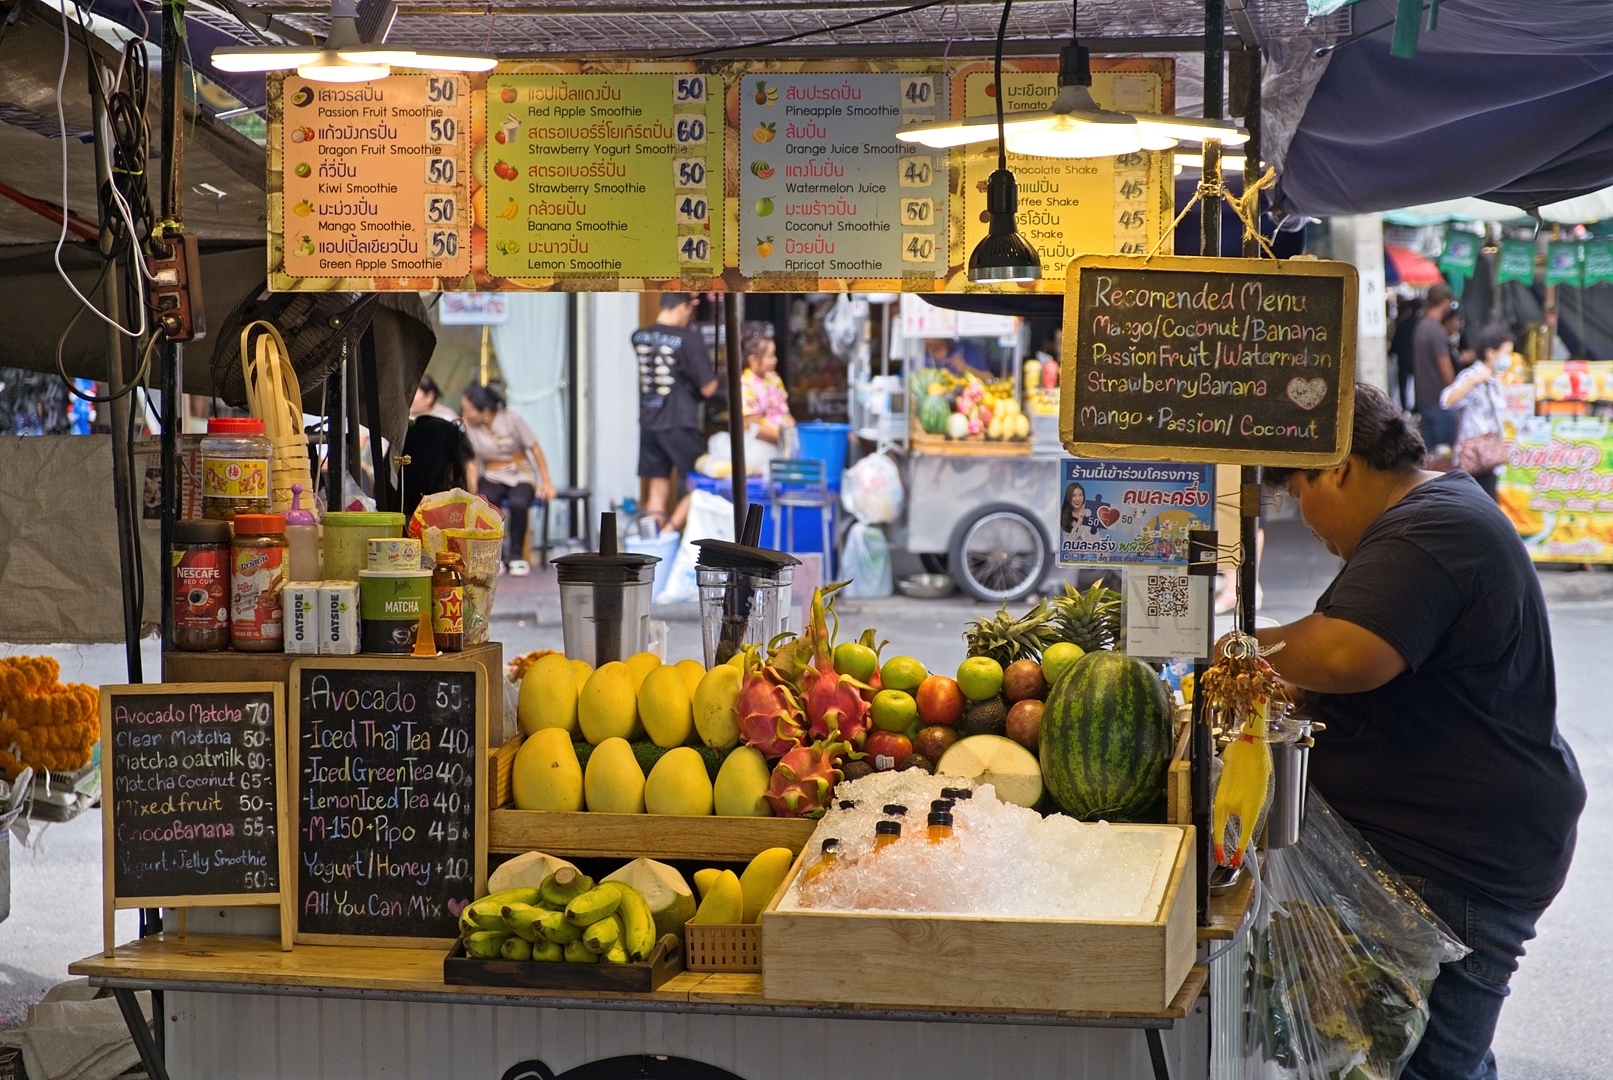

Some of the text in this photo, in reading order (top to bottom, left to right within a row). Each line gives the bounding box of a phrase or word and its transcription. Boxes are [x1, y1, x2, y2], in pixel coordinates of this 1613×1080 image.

[318, 82, 383, 102] เสาวรสปั่น
[429, 78, 454, 101] 50
[528, 81, 621, 100] แอปเปิ้ลแดงปั่น
[677, 78, 703, 100] 50
[786, 80, 861, 99] สับปะรดปั่น
[906, 82, 930, 103] 40
[318, 107, 443, 117] Passion Fruit Smoothie
[528, 106, 642, 118] Red Apple Smoothie
[786, 106, 899, 117] Pineapple Smoothie
[1008, 101, 1047, 109] Tomato
[318, 120, 396, 139] แก้วมังกรปั่น
[430, 118, 454, 141] 50
[677, 119, 704, 142] 60
[786, 119, 826, 138] ส้มปั่น
[318, 145, 441, 156] Dragon Fruit Smoothie
[529, 145, 589, 156] Strawberry
[594, 145, 631, 156] Yogurt
[786, 144, 916, 156] Orange Juice Smoothie
[428, 159, 454, 183] 50
[680, 163, 704, 185] 50
[786, 158, 843, 177] แตงโมปั่น
[905, 162, 930, 183] 40
[1066, 166, 1097, 174] Shake
[319, 183, 397, 193] Kiwi Smoothie
[529, 183, 646, 195] Strawberry Smoothie
[786, 183, 886, 193] Watermelon Juice
[1120, 180, 1146, 199] 45
[319, 196, 377, 215] มะม่วงปั่น
[429, 199, 454, 222] 50
[528, 196, 586, 215] กล้วยปั่น
[680, 197, 706, 219] 40
[786, 196, 856, 215] มะพร้าวปั่น
[907, 202, 929, 221] 50
[1017, 198, 1078, 206] offee Shake
[319, 221, 411, 233] Mango Smoothie
[528, 221, 627, 231] Banana Smoothie
[785, 221, 890, 231] Coconut Smoothie
[1119, 210, 1146, 229] 45
[432, 231, 457, 256] 50
[1031, 230, 1063, 238] Shake
[528, 235, 588, 254] มะนาวปั่น
[681, 238, 707, 259] 40
[907, 237, 932, 257] 40
[320, 259, 442, 271] Green Apple Smoothie
[528, 259, 621, 269] Lemon Smoothie
[785, 260, 882, 271] Apricot Smoothie
[1095, 276, 1307, 311] Recomended Menu
[1080, 405, 1142, 430] Mango
[1241, 415, 1318, 439] Coconut
[1072, 463, 1199, 481] ร้านนี้เข้าร่วมโครงการ
[1123, 482, 1209, 506] คนละครึ่ง
[1088, 515, 1132, 527] 50 50
[1063, 535, 1116, 551] คนละครึ่ง
[386, 602, 419, 612] MATCHA
[446, 602, 461, 616] M
[295, 594, 304, 641] OATSIDE
[331, 595, 339, 641] OATSIDE
[115, 703, 270, 725] Avocado Matcha 70
[117, 731, 162, 747] Clear
[171, 731, 231, 745] Matcha
[117, 752, 178, 770] Matcha
[116, 773, 174, 792] Matcha
[178, 772, 235, 787] Coconut
[214, 849, 267, 867] Smoothie
[305, 891, 441, 920] All You Can Mix
